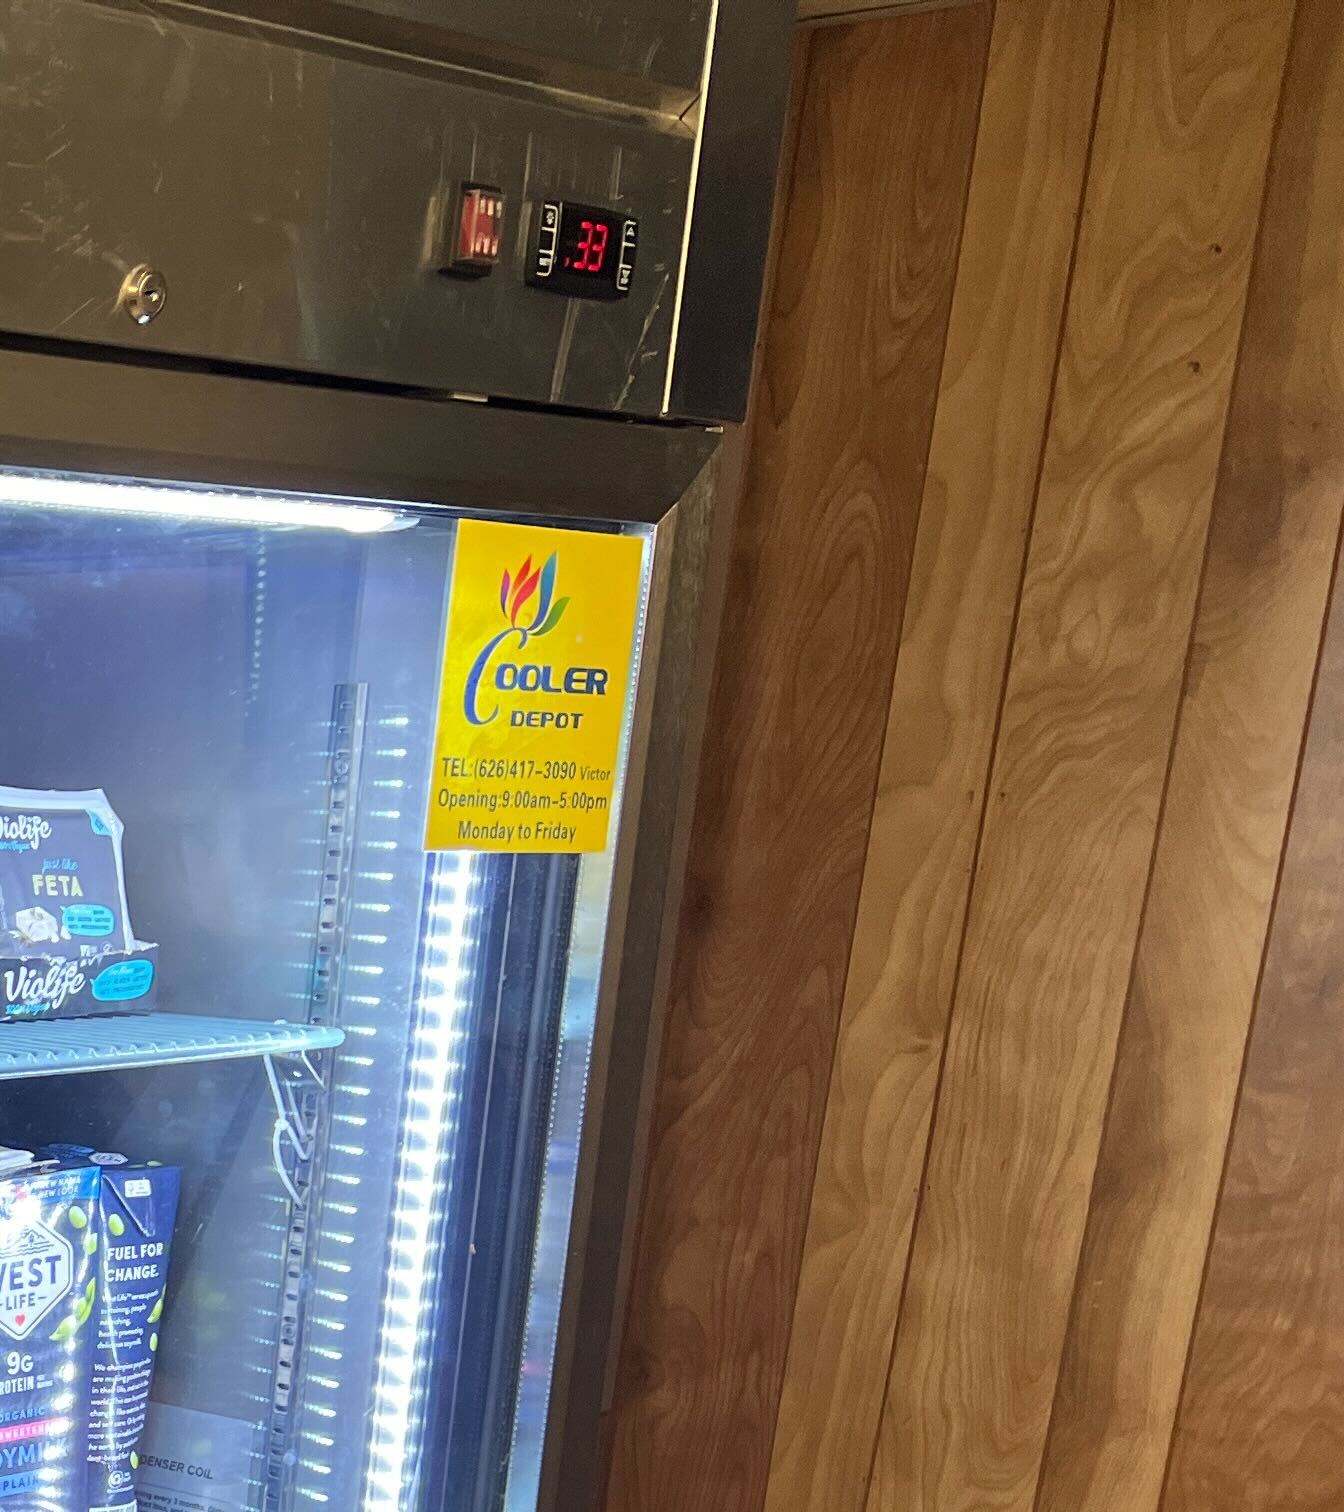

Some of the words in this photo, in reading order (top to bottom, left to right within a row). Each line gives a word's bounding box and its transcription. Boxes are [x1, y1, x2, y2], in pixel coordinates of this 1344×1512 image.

[464, 626, 608, 726] COOLER
[510, 710, 584, 729] DEPOT
[580, 765, 611, 781] Victor
[458, 820, 515, 844] Monday
[518, 825, 531, 840] to
[535, 821, 577, 844] Friday
[32, 874, 84, 897] FETA
[4, 964, 86, 1010] Violife
[107, 1245, 139, 1261] FUEL
[140, 1242, 164, 1259] FOR
[105, 1264, 160, 1283] CHANGE.
[6, 1292, 36, 1311] LIFE
[7, 1351, 34, 1375] 9G
[140, 1454, 185, 1473] DENSER
[187, 1464, 214, 1480] COIL
